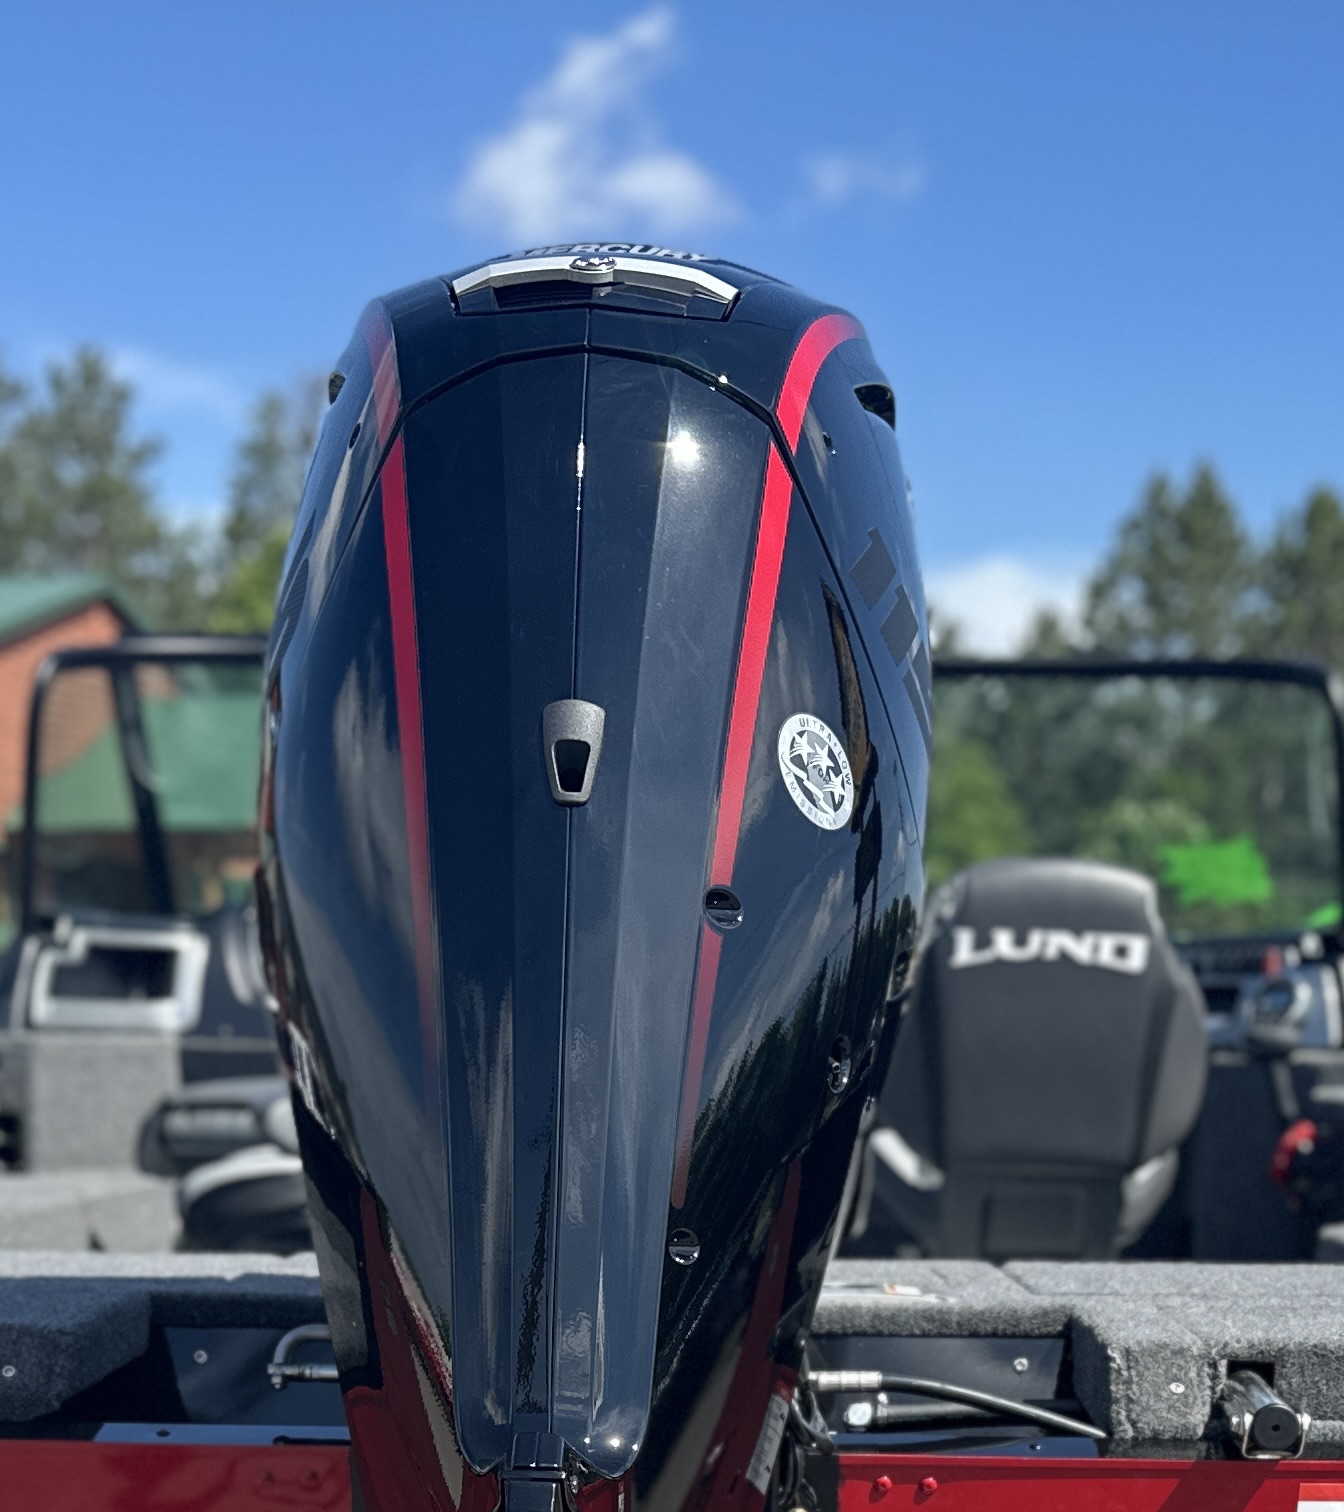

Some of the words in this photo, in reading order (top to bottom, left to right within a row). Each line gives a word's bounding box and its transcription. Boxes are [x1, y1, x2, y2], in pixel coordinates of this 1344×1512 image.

[798, 717, 833, 743] ULTRA
[837, 749, 852, 786] LOW
[949, 926, 1151, 977] LUND
